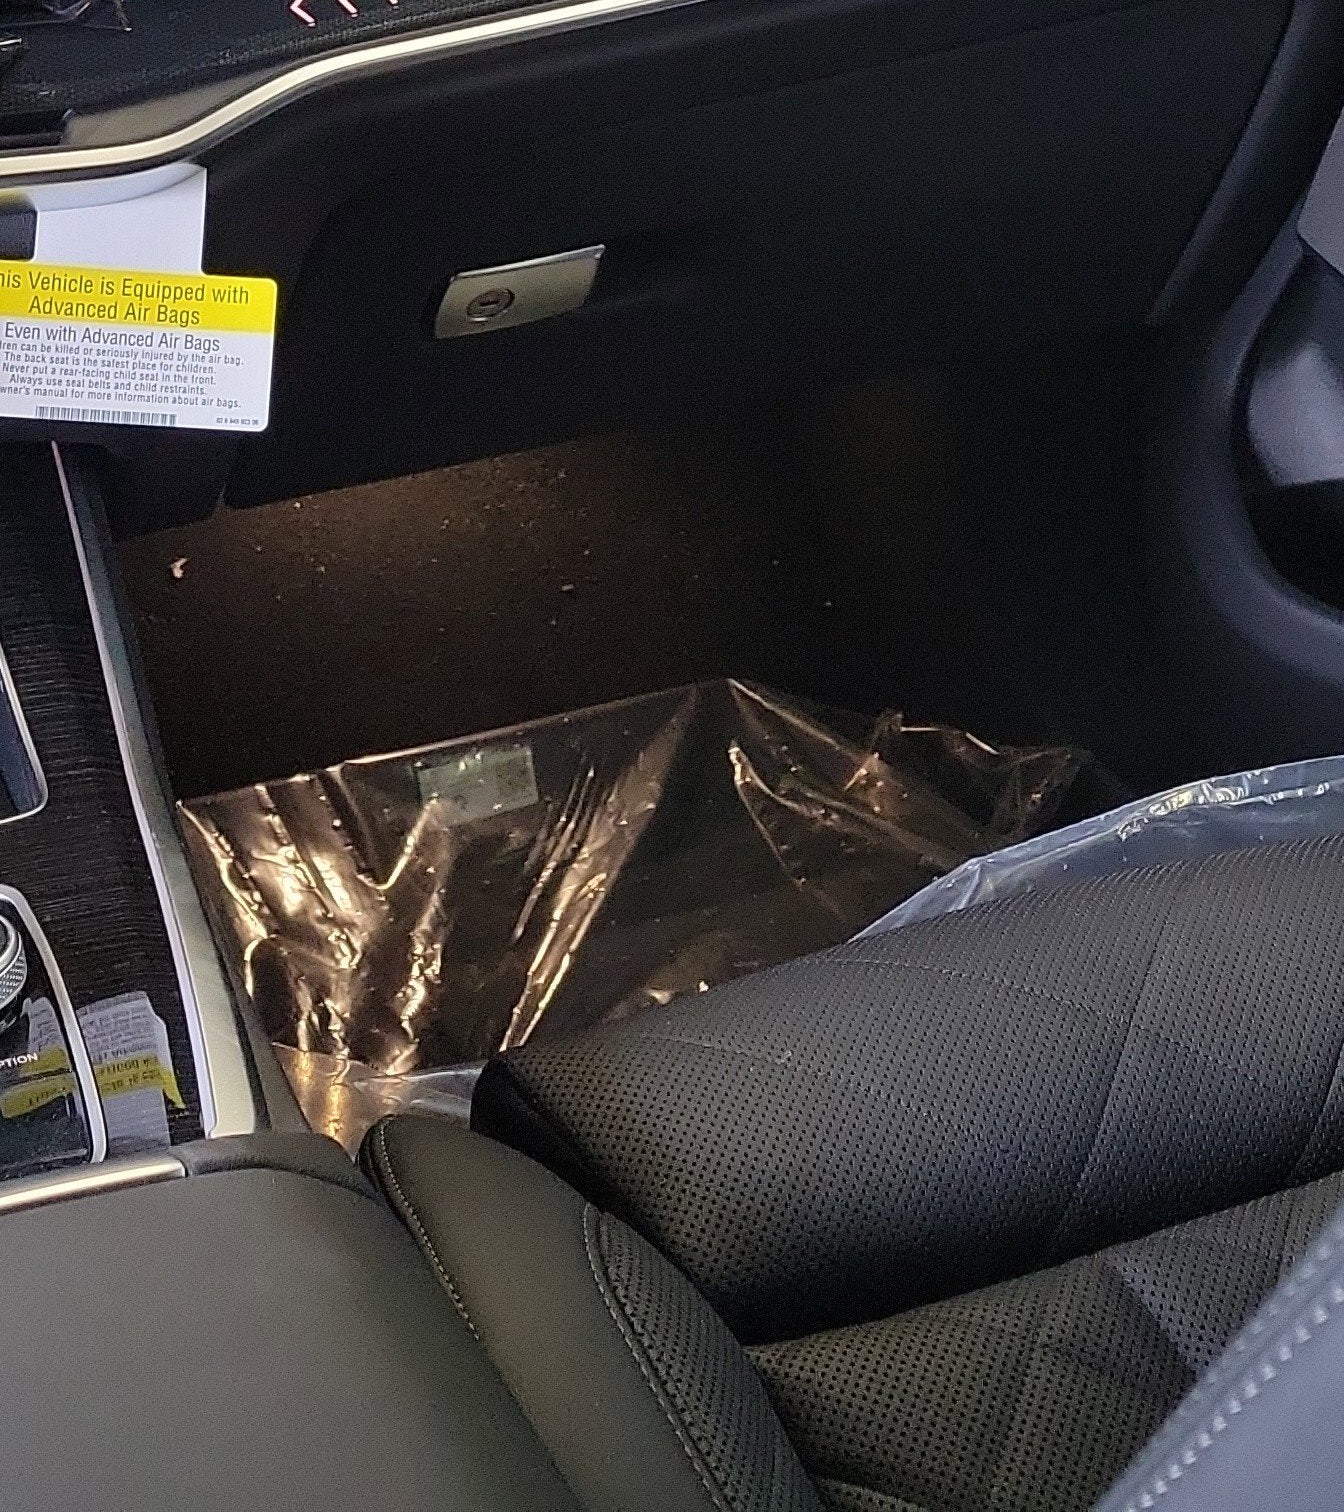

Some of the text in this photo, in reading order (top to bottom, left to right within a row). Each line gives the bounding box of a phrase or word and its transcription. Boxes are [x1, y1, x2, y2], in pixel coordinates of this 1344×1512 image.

[28, 271, 93, 294] Vehicle
[100, 276, 115, 295] is
[122, 278, 205, 304] Equipped
[212, 285, 249, 304] with
[28, 295, 200, 328] Advanced Air Bags
[5, 321, 220, 354] Even with Advanced Air Bags
[4, 351, 216, 374] The back seat is the safest place for children.
[20, 343, 37, 352] can
[40, 343, 52, 353] be
[55, 344, 80, 355] killed
[83, 347, 94, 356] or
[96, 348, 139, 360] seriously
[141, 349, 174, 361] injured
[177, 352, 189, 364] by
[191, 353, 206, 363] the
[208, 355, 222, 364] air
[224, 355, 244, 367] bag.
[2, 362, 30, 373] Never
[32, 365, 48, 375] put
[59, 367, 111, 380] rear-facing
[113, 370, 137, 380] child
[139, 372, 159, 382] seat
[162, 373, 170, 382] in
[173, 374, 188, 383] the
[191, 375, 216, 385] front.
[9, 374, 208, 395] Always use seat belts and child restraints.
[33, 387, 68, 397] manual
[71, 388, 85, 399] for
[88, 391, 112, 400] more
[114, 392, 169, 404] information
[171, 395, 199, 406] about
[201, 397, 214, 406] air
[216, 398, 242, 409] bags.
